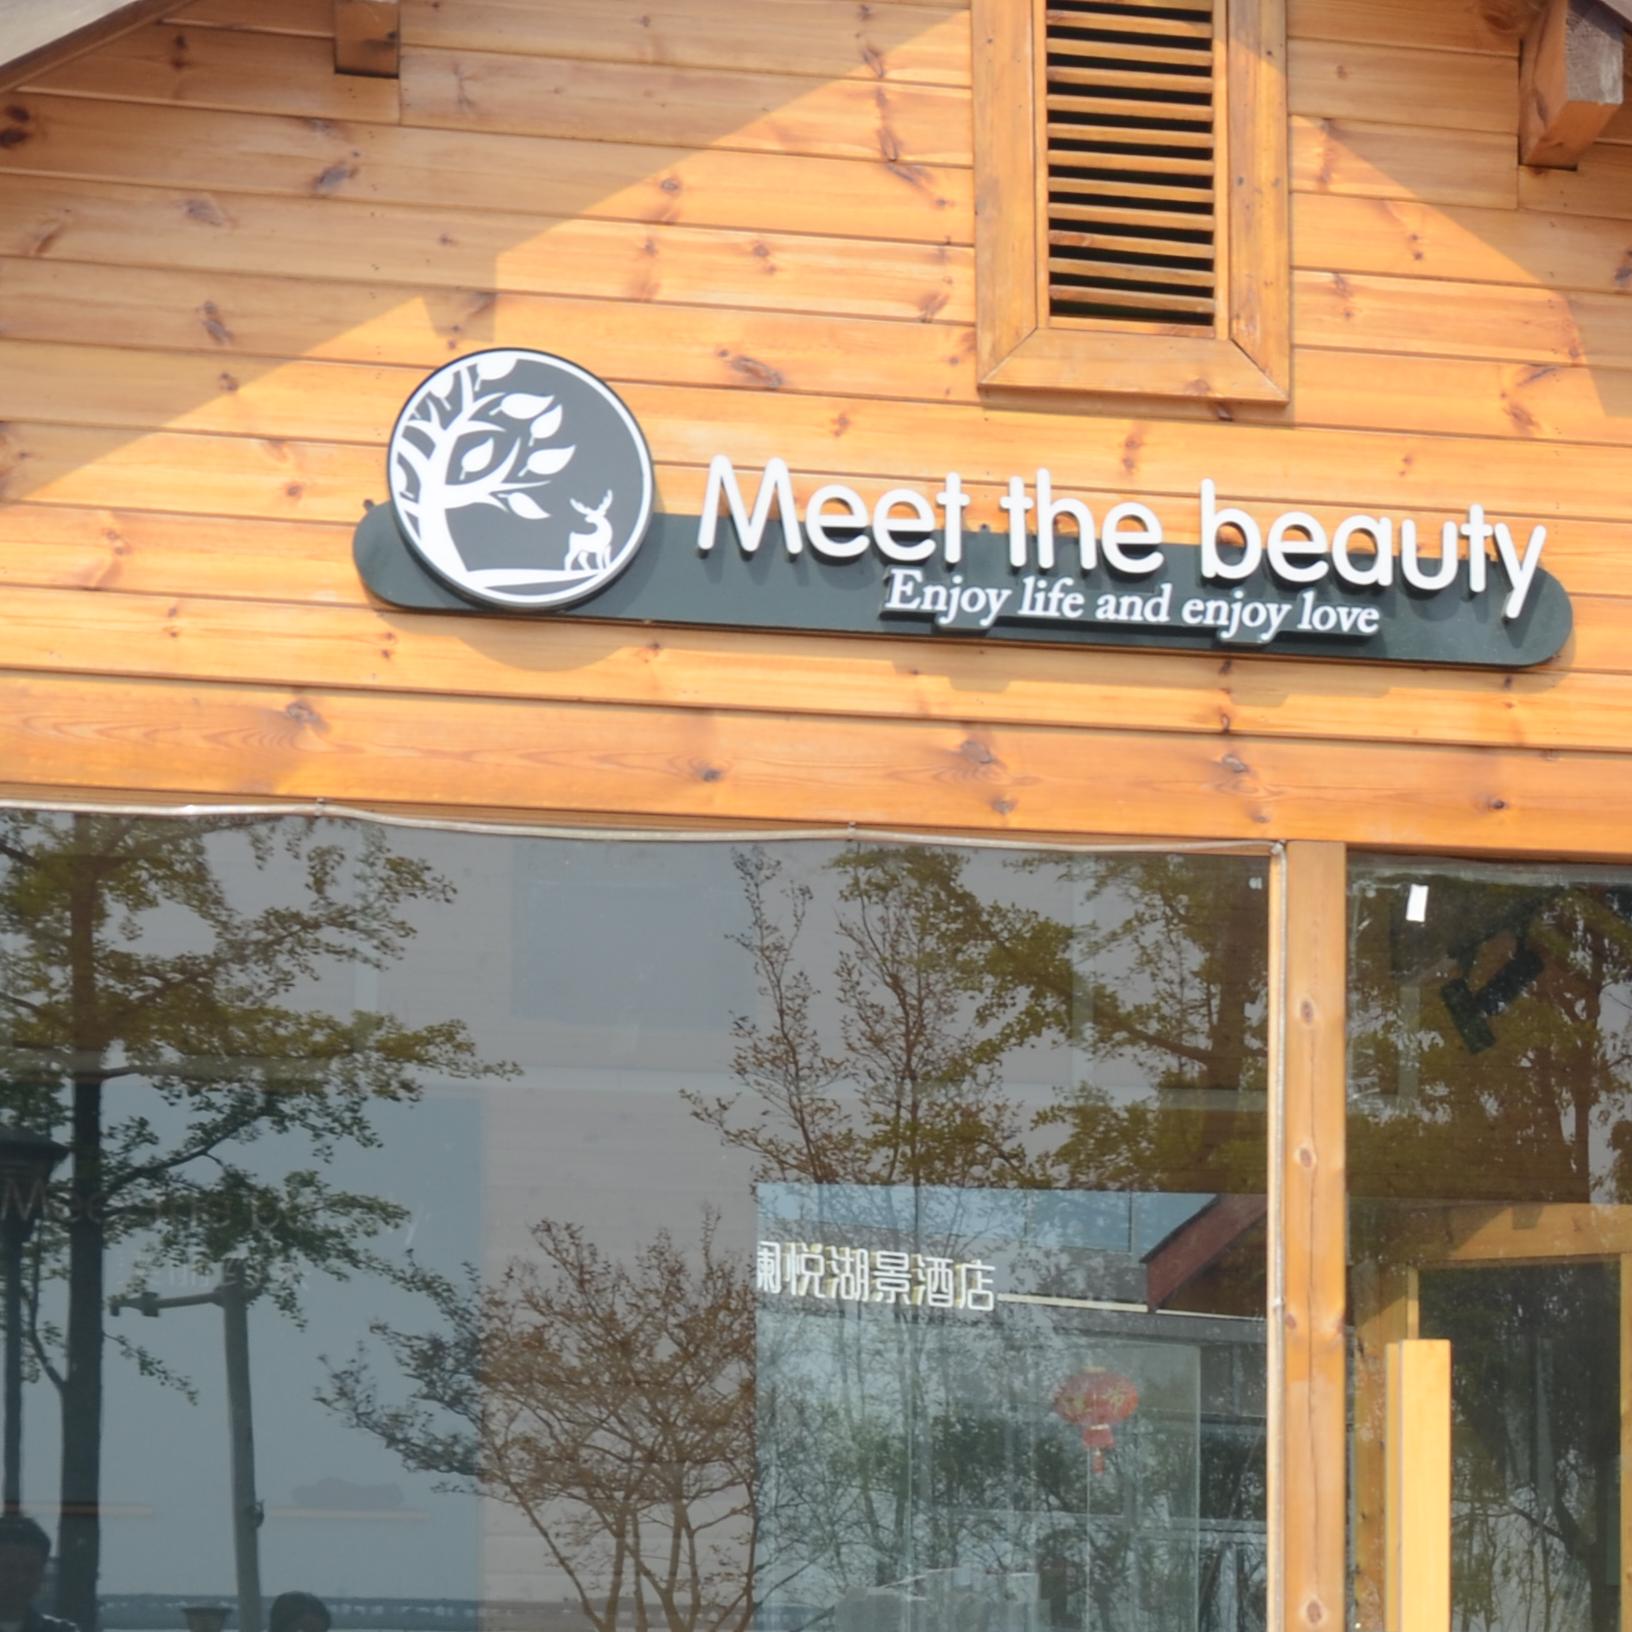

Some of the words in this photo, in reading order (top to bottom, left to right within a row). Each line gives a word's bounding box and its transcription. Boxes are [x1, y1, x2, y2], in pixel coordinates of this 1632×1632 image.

[697, 454, 970, 564] Meet
[1000, 467, 1164, 574] the
[1200, 478, 1547, 619] beauty
[884, 567, 1012, 626] Enjoy
[1016, 575, 1084, 618] life
[1096, 582, 1173, 622] and
[1182, 590, 1291, 641] enjoy
[1297, 590, 1380, 633] love
